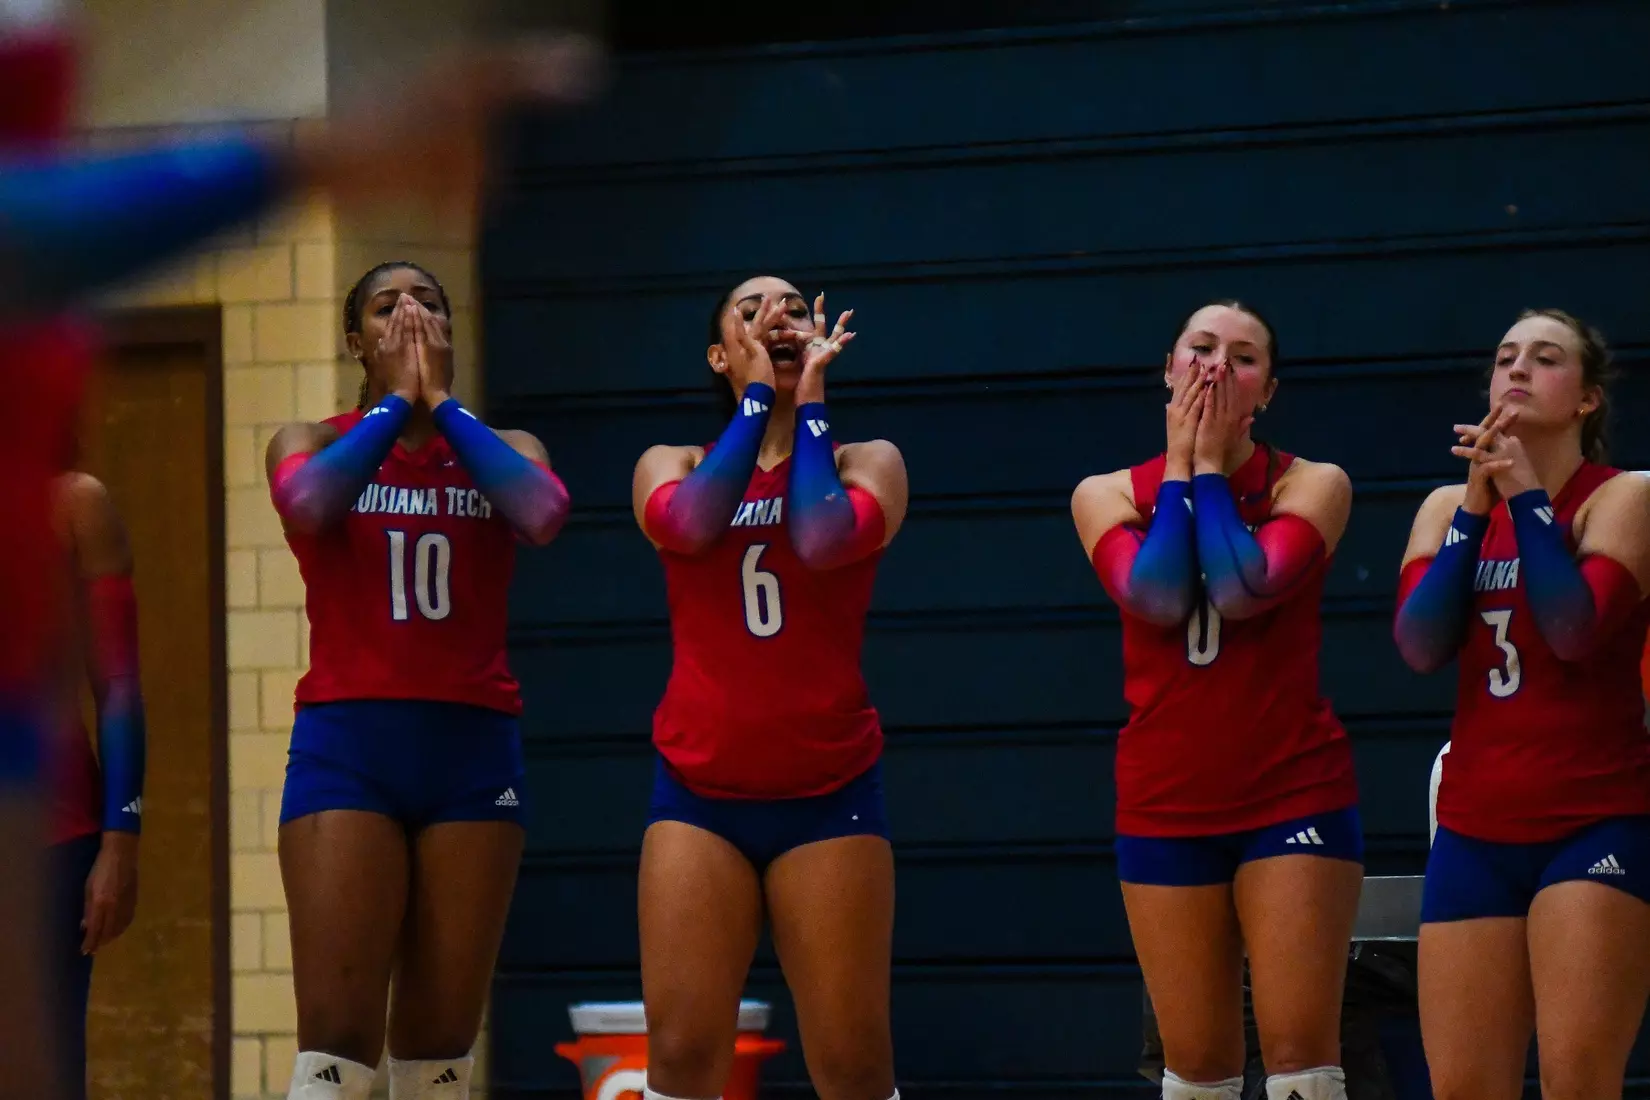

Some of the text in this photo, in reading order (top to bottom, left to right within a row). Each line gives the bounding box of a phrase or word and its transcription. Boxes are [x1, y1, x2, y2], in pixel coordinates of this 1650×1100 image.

[351, 483, 492, 519] UISIANA TECH
[730, 496, 783, 526] IANA
[386, 530, 451, 620] 10
[741, 543, 783, 637] 6
[1474, 557, 1520, 591] IANA
[1187, 600, 1222, 666] 0
[1480, 609, 1521, 697] 3
[1587, 866, 1626, 875] adidas
